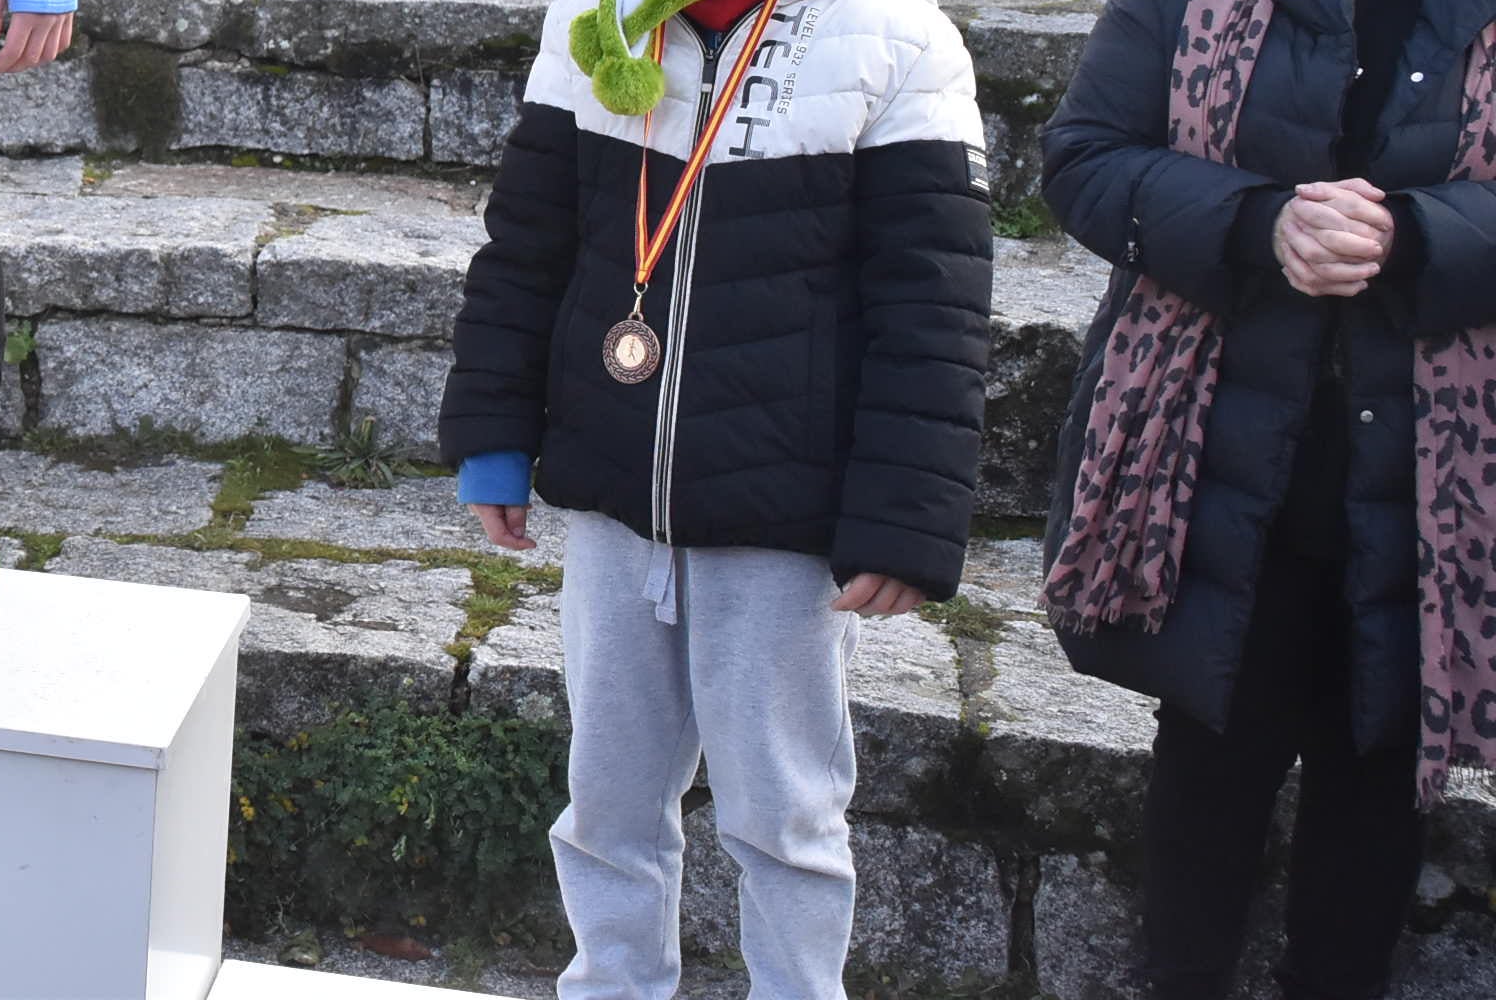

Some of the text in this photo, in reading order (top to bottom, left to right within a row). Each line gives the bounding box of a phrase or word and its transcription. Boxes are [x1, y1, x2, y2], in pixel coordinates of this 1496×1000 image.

[800, 7, 821, 42] LEVEL
[728, 6, 808, 160] TECH
[776, 73, 797, 115] SERIES
